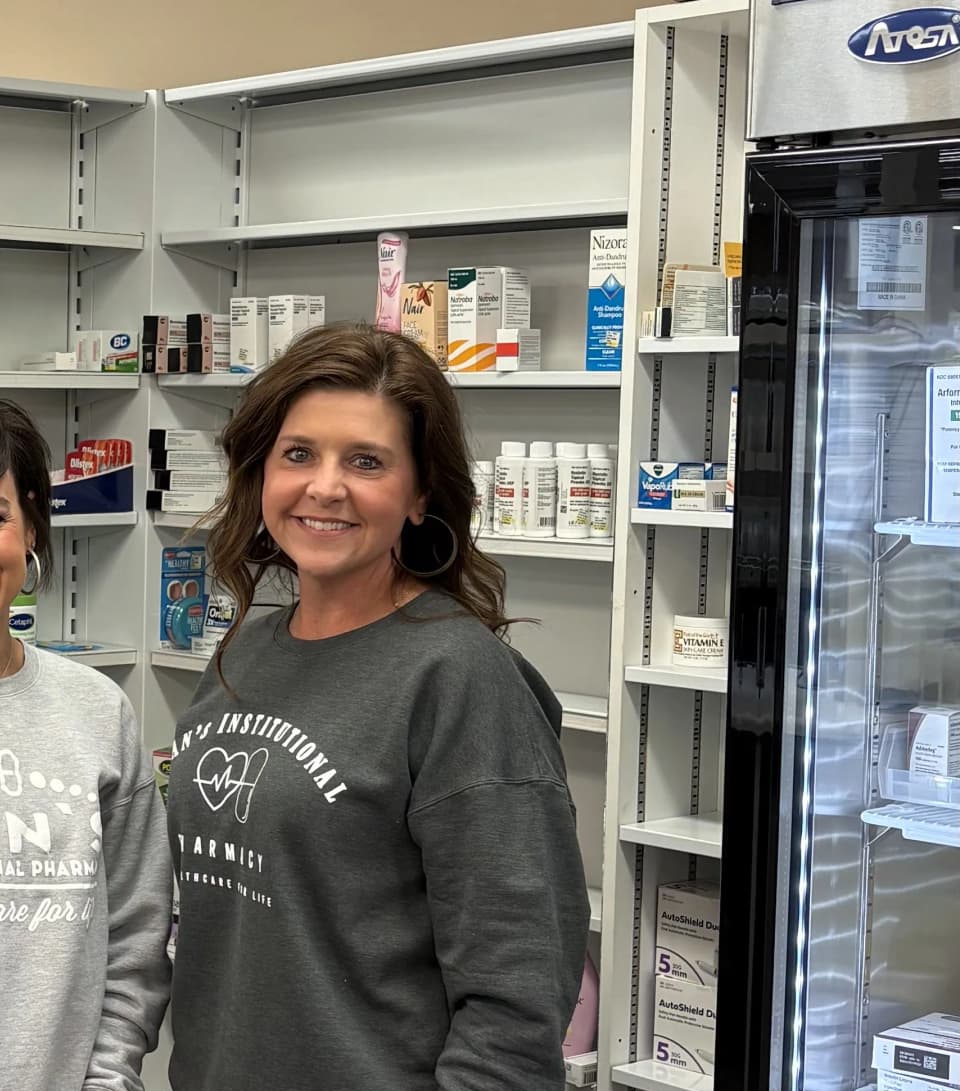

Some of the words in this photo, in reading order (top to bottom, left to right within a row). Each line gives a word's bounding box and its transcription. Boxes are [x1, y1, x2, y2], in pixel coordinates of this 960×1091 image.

[113, 336, 128, 348] BC
[683, 638, 718, 647] VITAMIN
[217, 713, 348, 804] INSTITUTIONAL
[27, 897, 78, 931] for
[661, 911, 704, 928] AutoShield
[658, 953, 672, 974] 5
[659, 999, 705, 1017] AutoShield
[656, 1041, 670, 1062] 5
